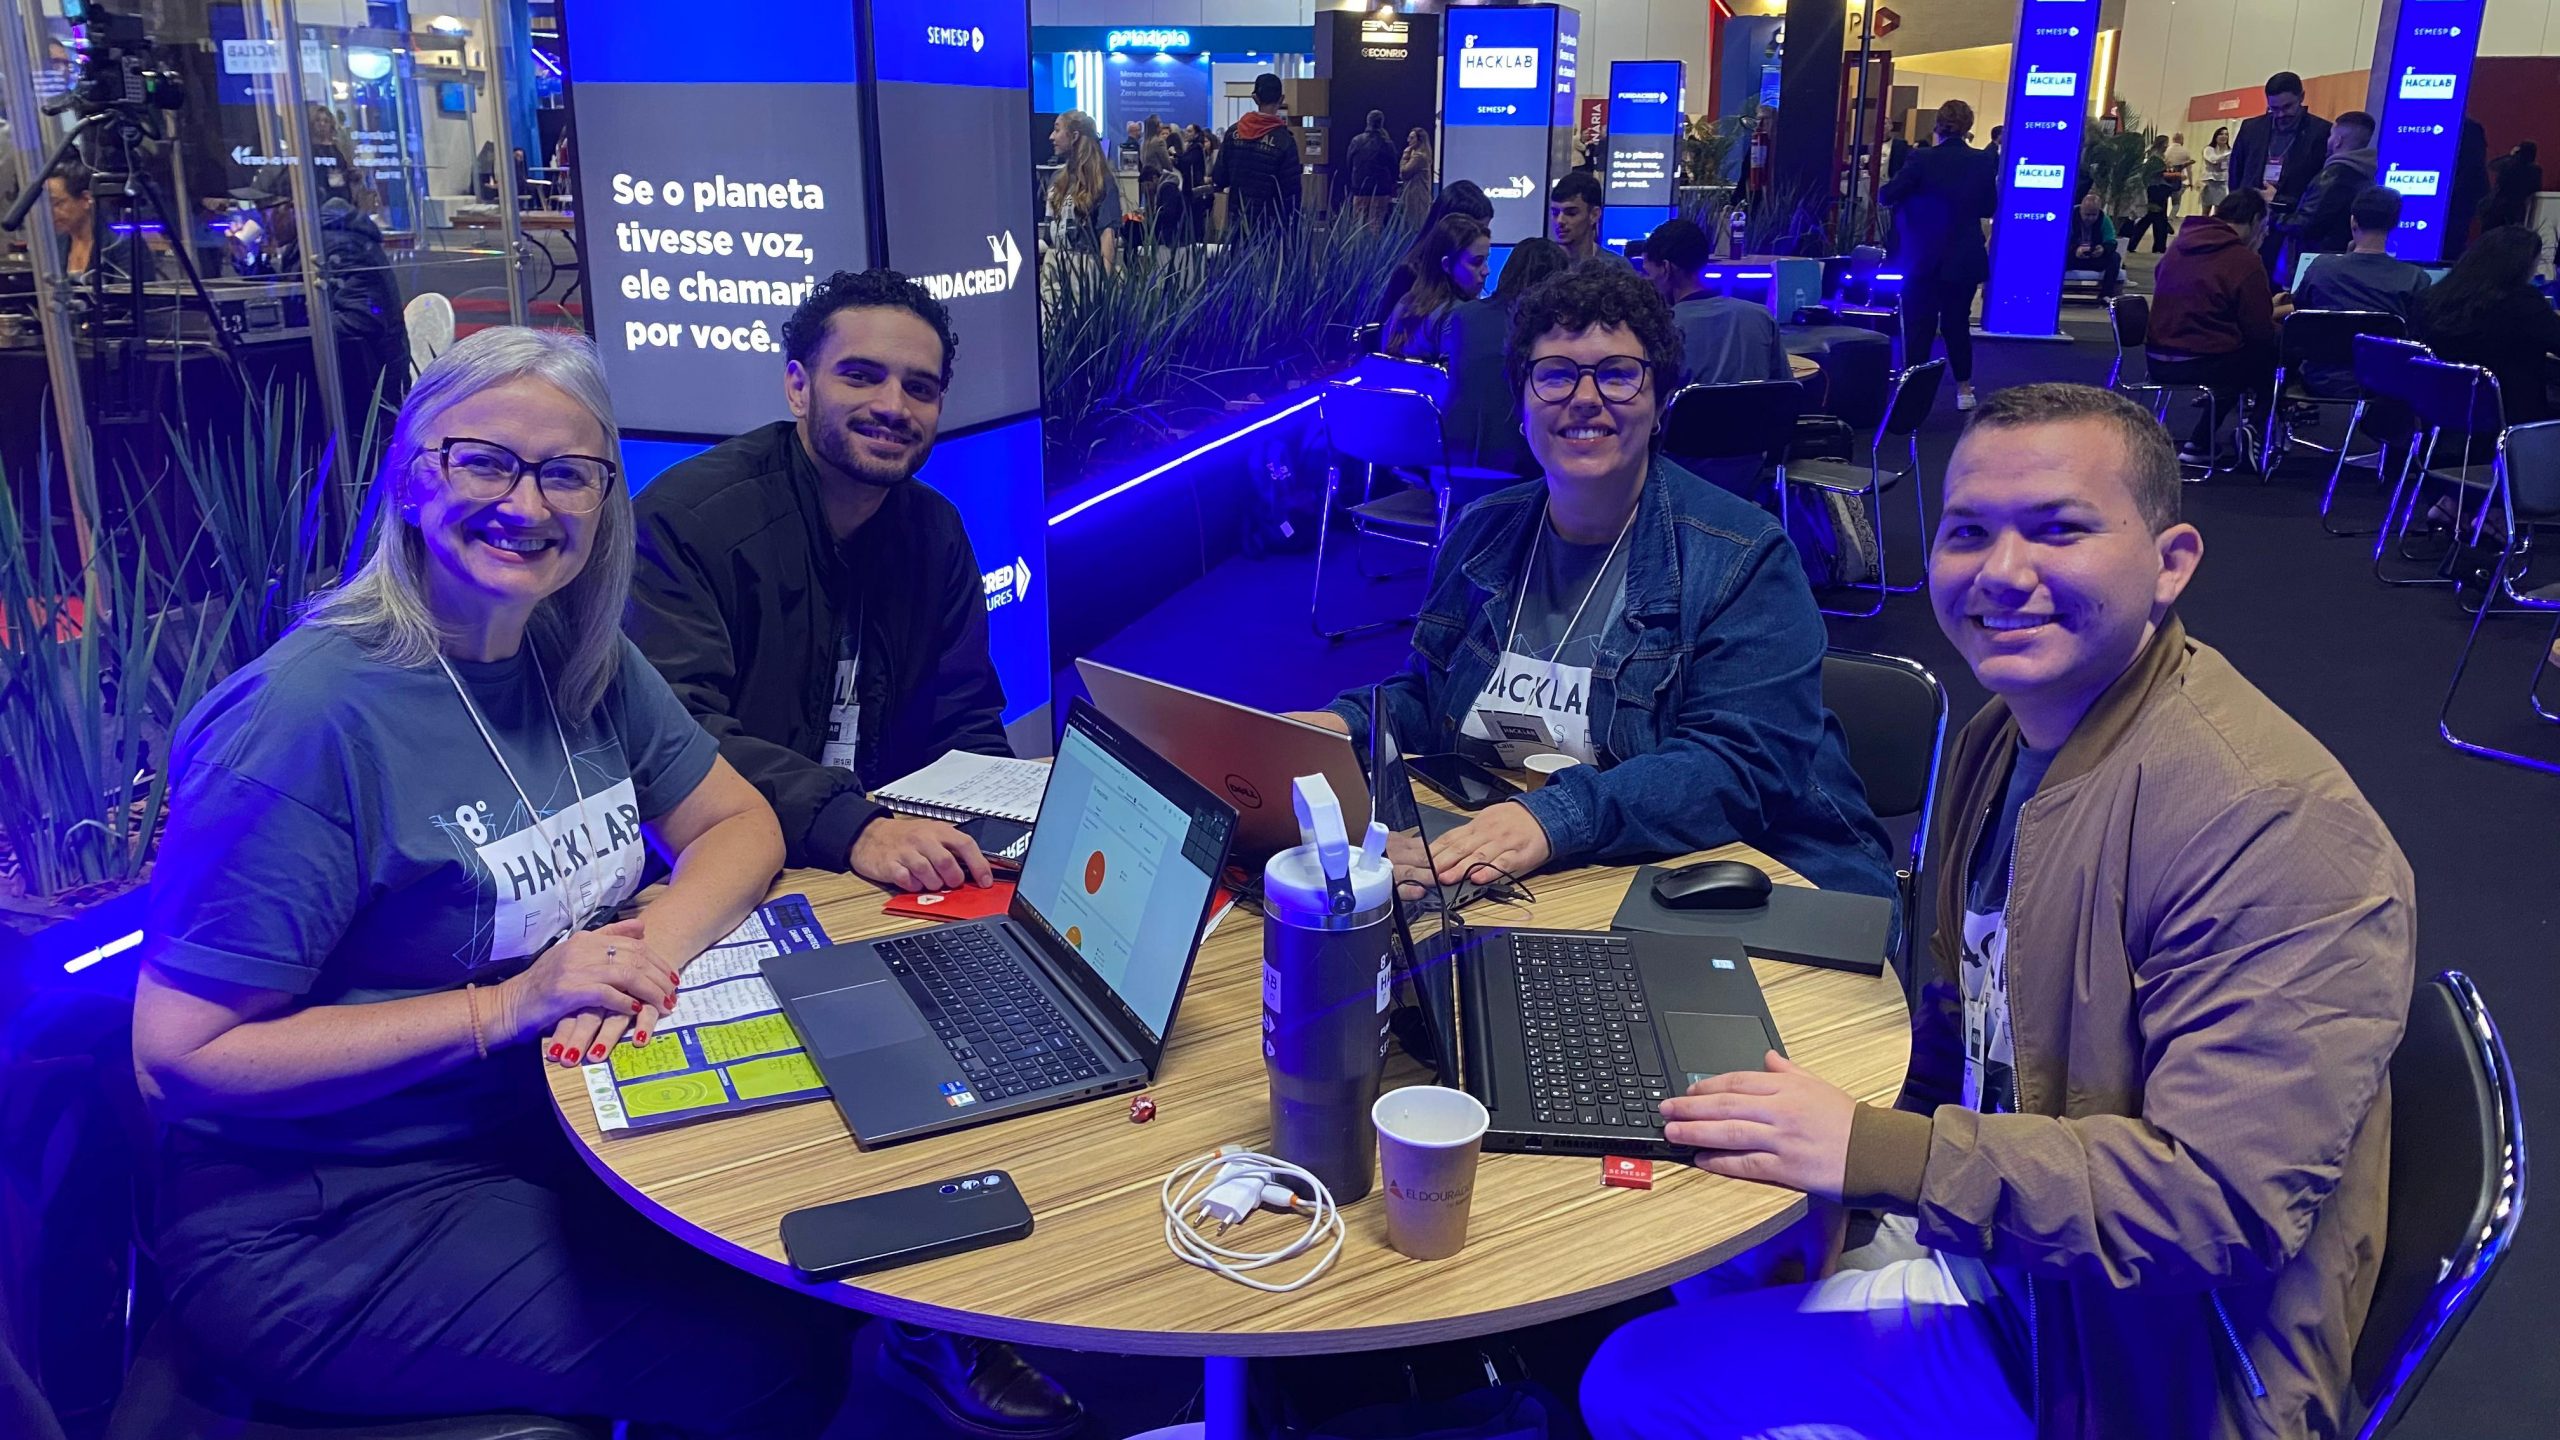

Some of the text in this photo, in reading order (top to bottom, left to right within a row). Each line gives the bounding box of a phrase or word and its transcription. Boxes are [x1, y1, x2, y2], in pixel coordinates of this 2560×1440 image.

[928, 26, 969, 46] SEMESP
[2414, 28, 2449, 36] SEMESP
[1477, 106, 1507, 114] SEMESP
[612, 173, 825, 213] Se o planeta
[616, 221, 814, 265] tivesse voz,
[621, 269, 830, 306] ele chamari
[625, 320, 781, 353] por você.
[981, 565, 1014, 594] RED
[1483, 667, 1590, 716] ACKLA
[1229, 783, 1258, 800] DELL
[456, 800, 488, 845] 8°
[502, 803, 640, 902] HACKLAB
[1609, 1168, 1648, 1177] SEMESP
